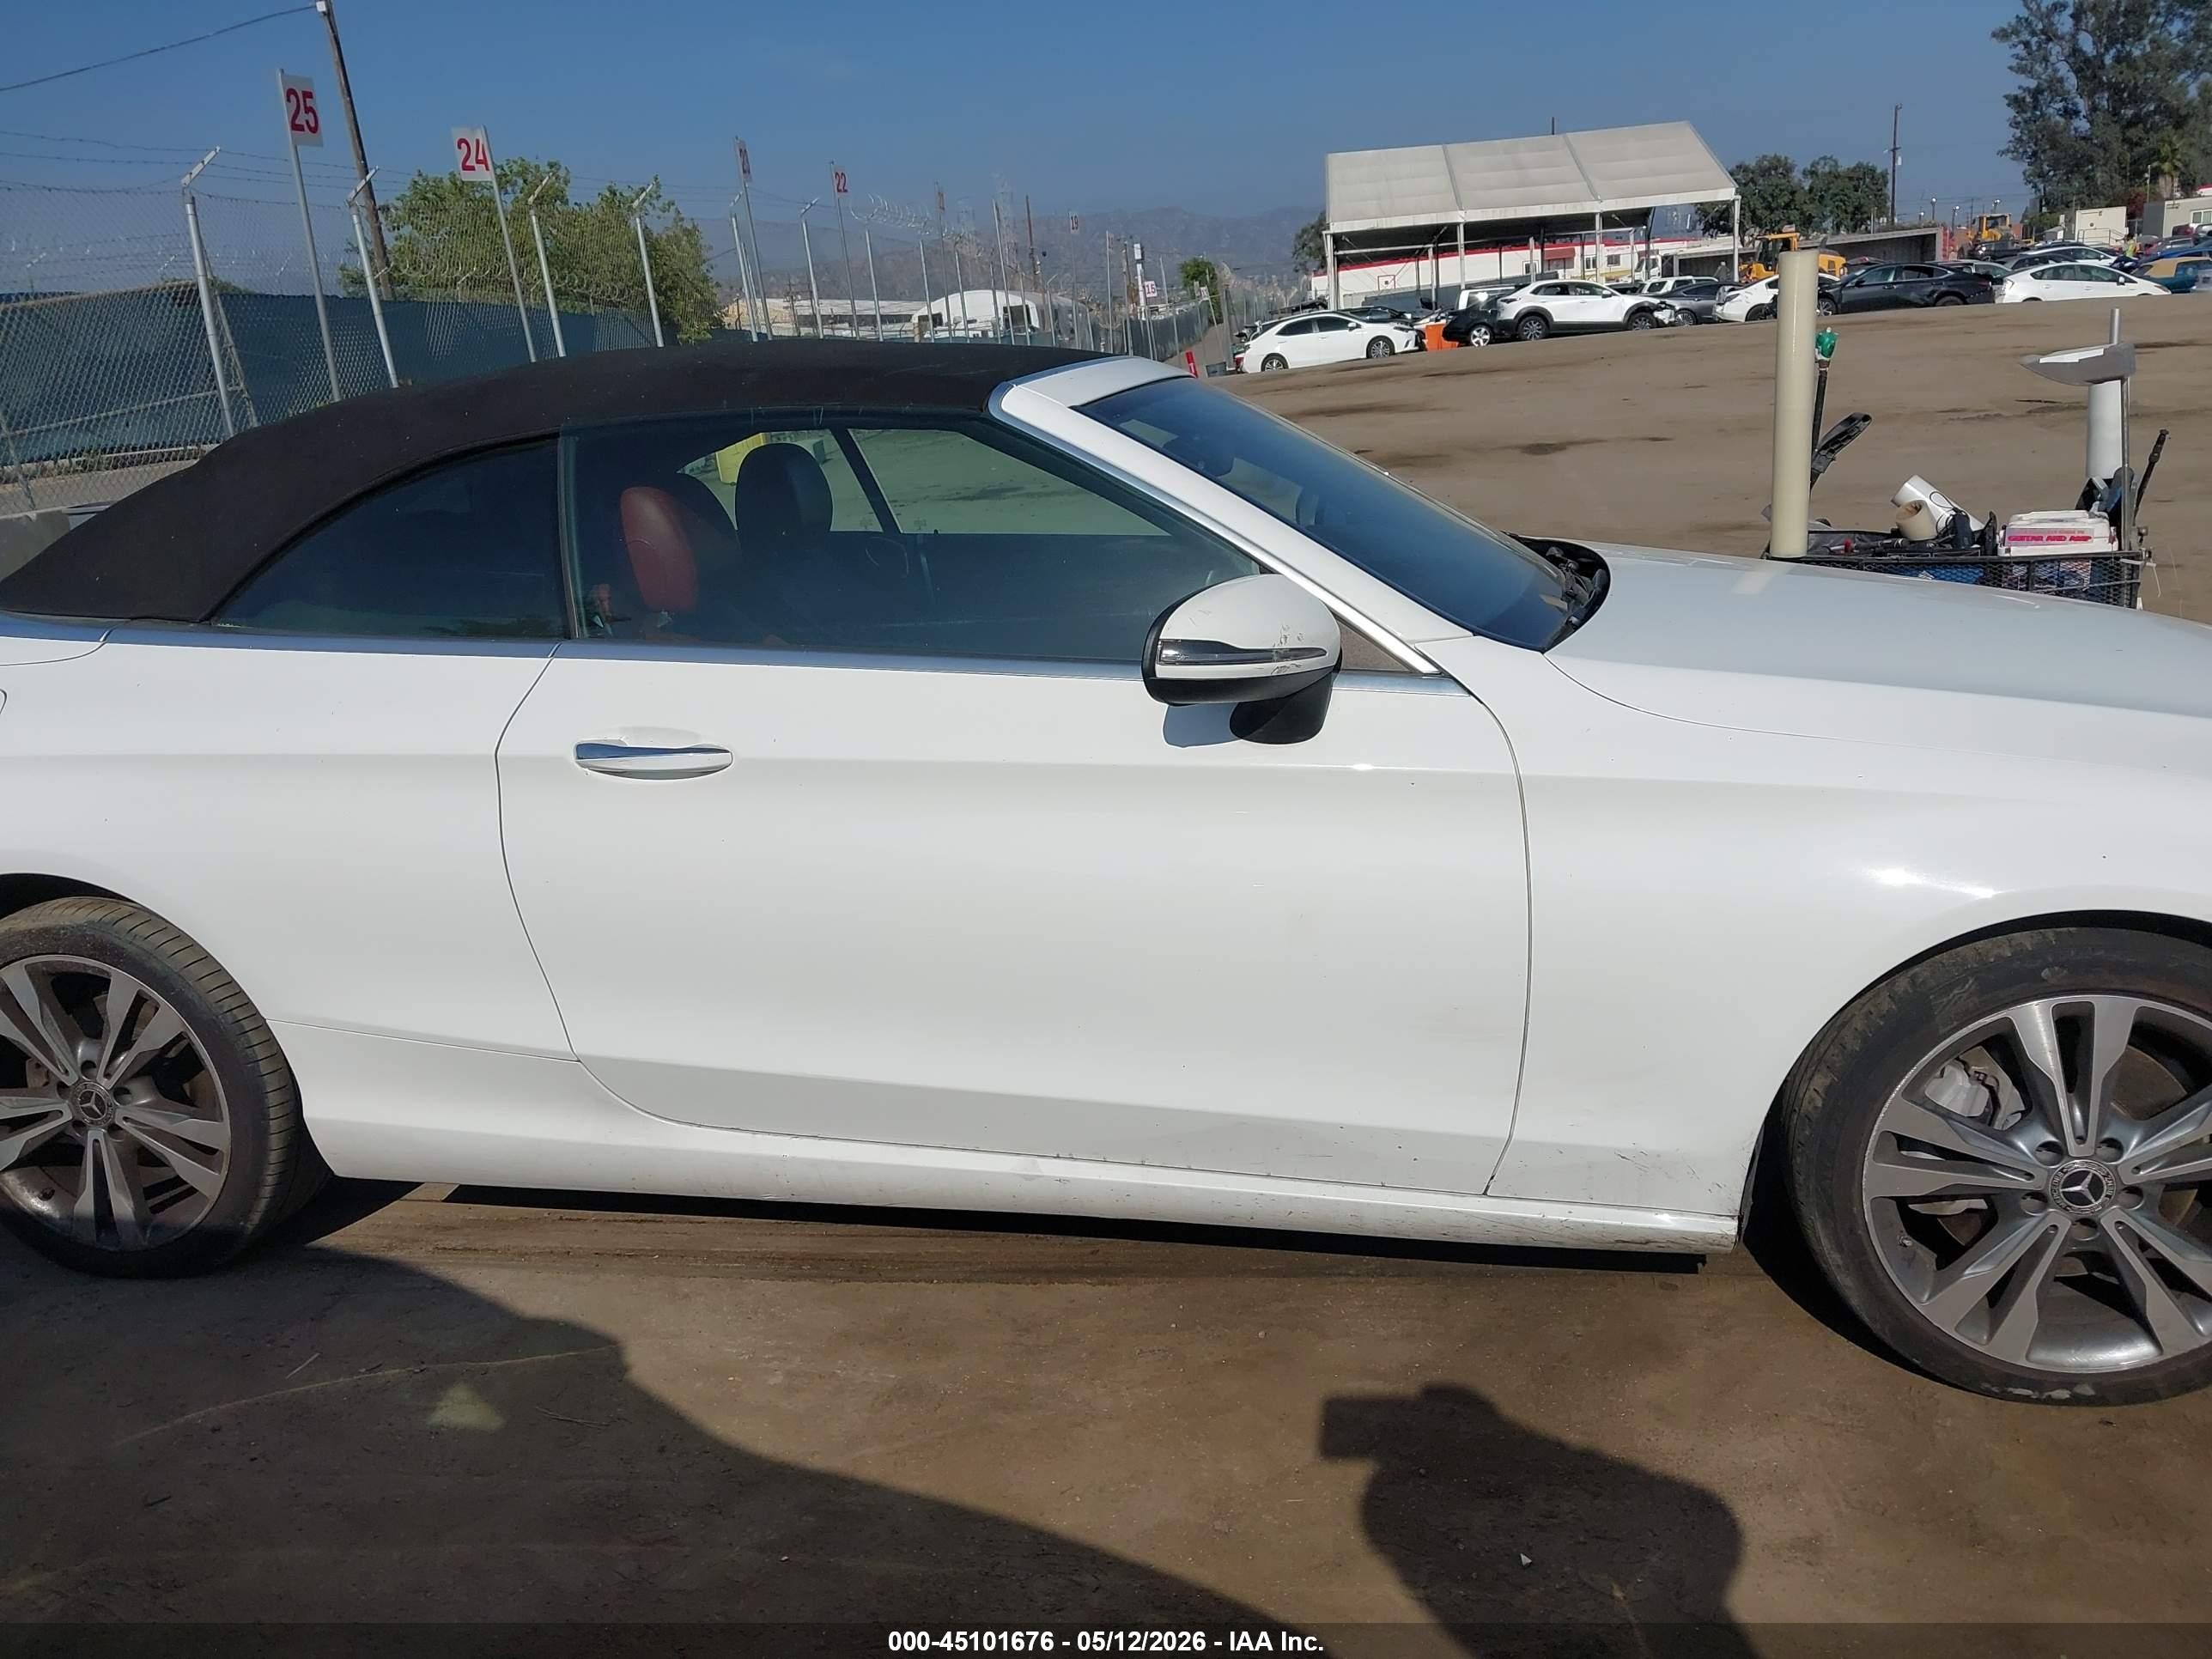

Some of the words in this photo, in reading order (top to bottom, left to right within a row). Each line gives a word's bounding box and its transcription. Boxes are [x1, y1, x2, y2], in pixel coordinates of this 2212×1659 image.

[286, 87, 319, 134] 25
[457, 137, 490, 172] 24
[835, 171, 848, 193] 22
